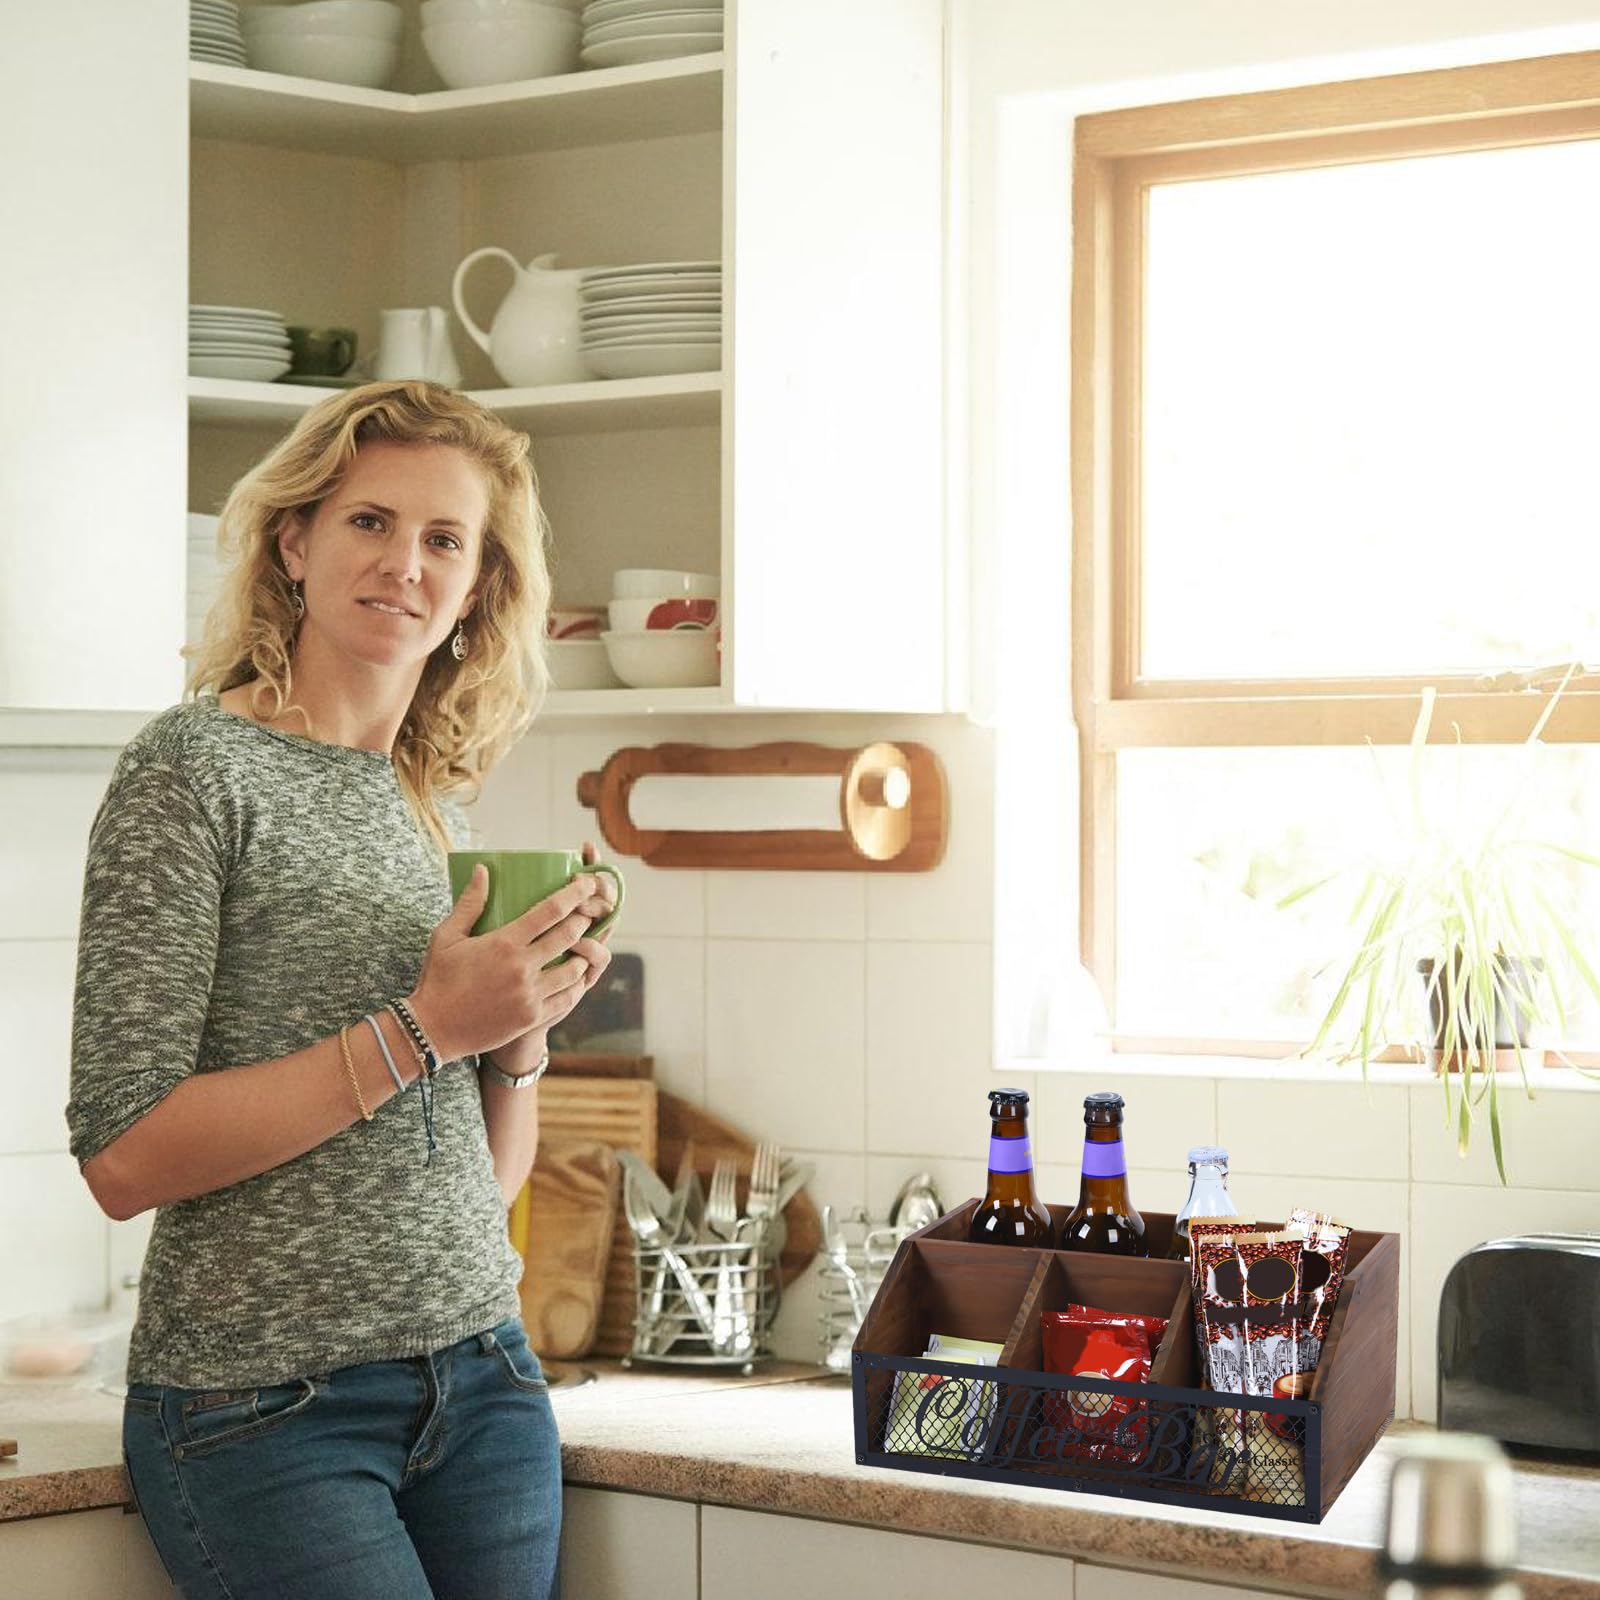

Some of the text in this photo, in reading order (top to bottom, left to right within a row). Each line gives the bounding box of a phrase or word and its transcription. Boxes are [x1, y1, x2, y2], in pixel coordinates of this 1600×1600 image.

[915, 1379, 1251, 1488] Coffee Bar
[1253, 1454, 1301, 1467] Classic
